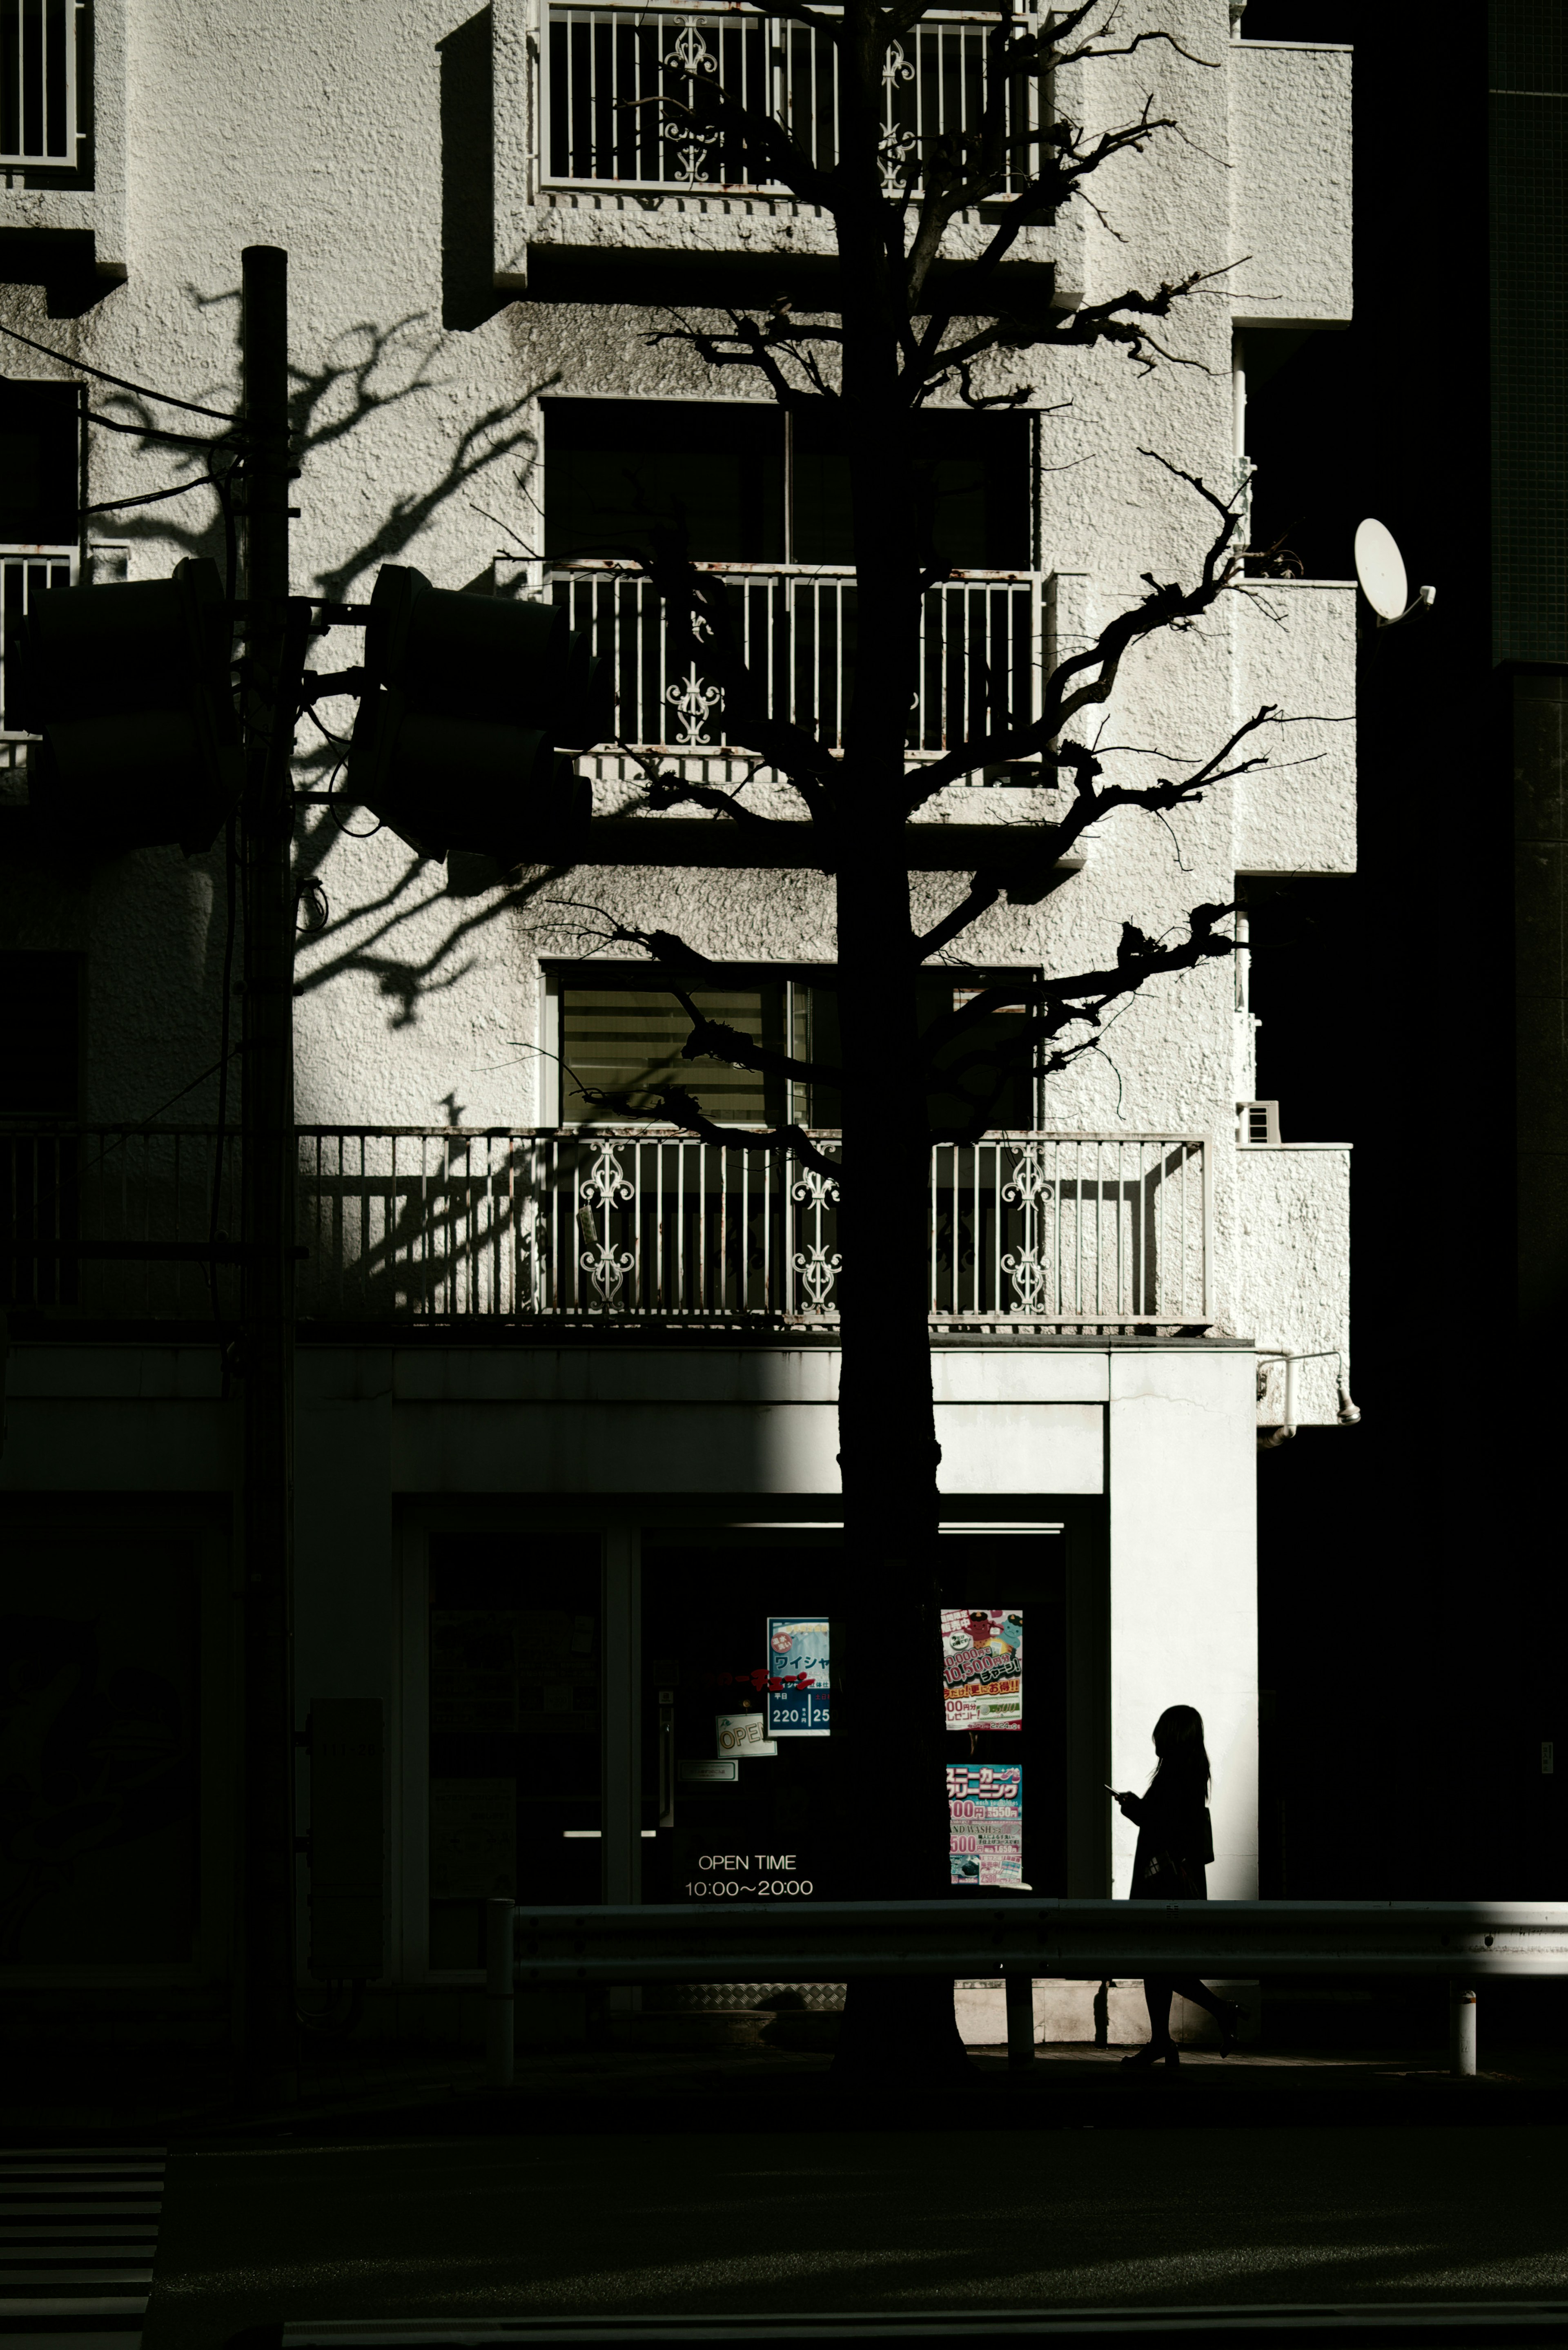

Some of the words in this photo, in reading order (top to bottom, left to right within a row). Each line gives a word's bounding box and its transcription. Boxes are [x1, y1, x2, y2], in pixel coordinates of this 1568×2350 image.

[773, 1710, 799, 1722] 220
[699, 1855, 749, 1870] OPEN
[755, 1855, 796, 1870] TIME
[686, 1881, 813, 1896] 10:00～20:00
